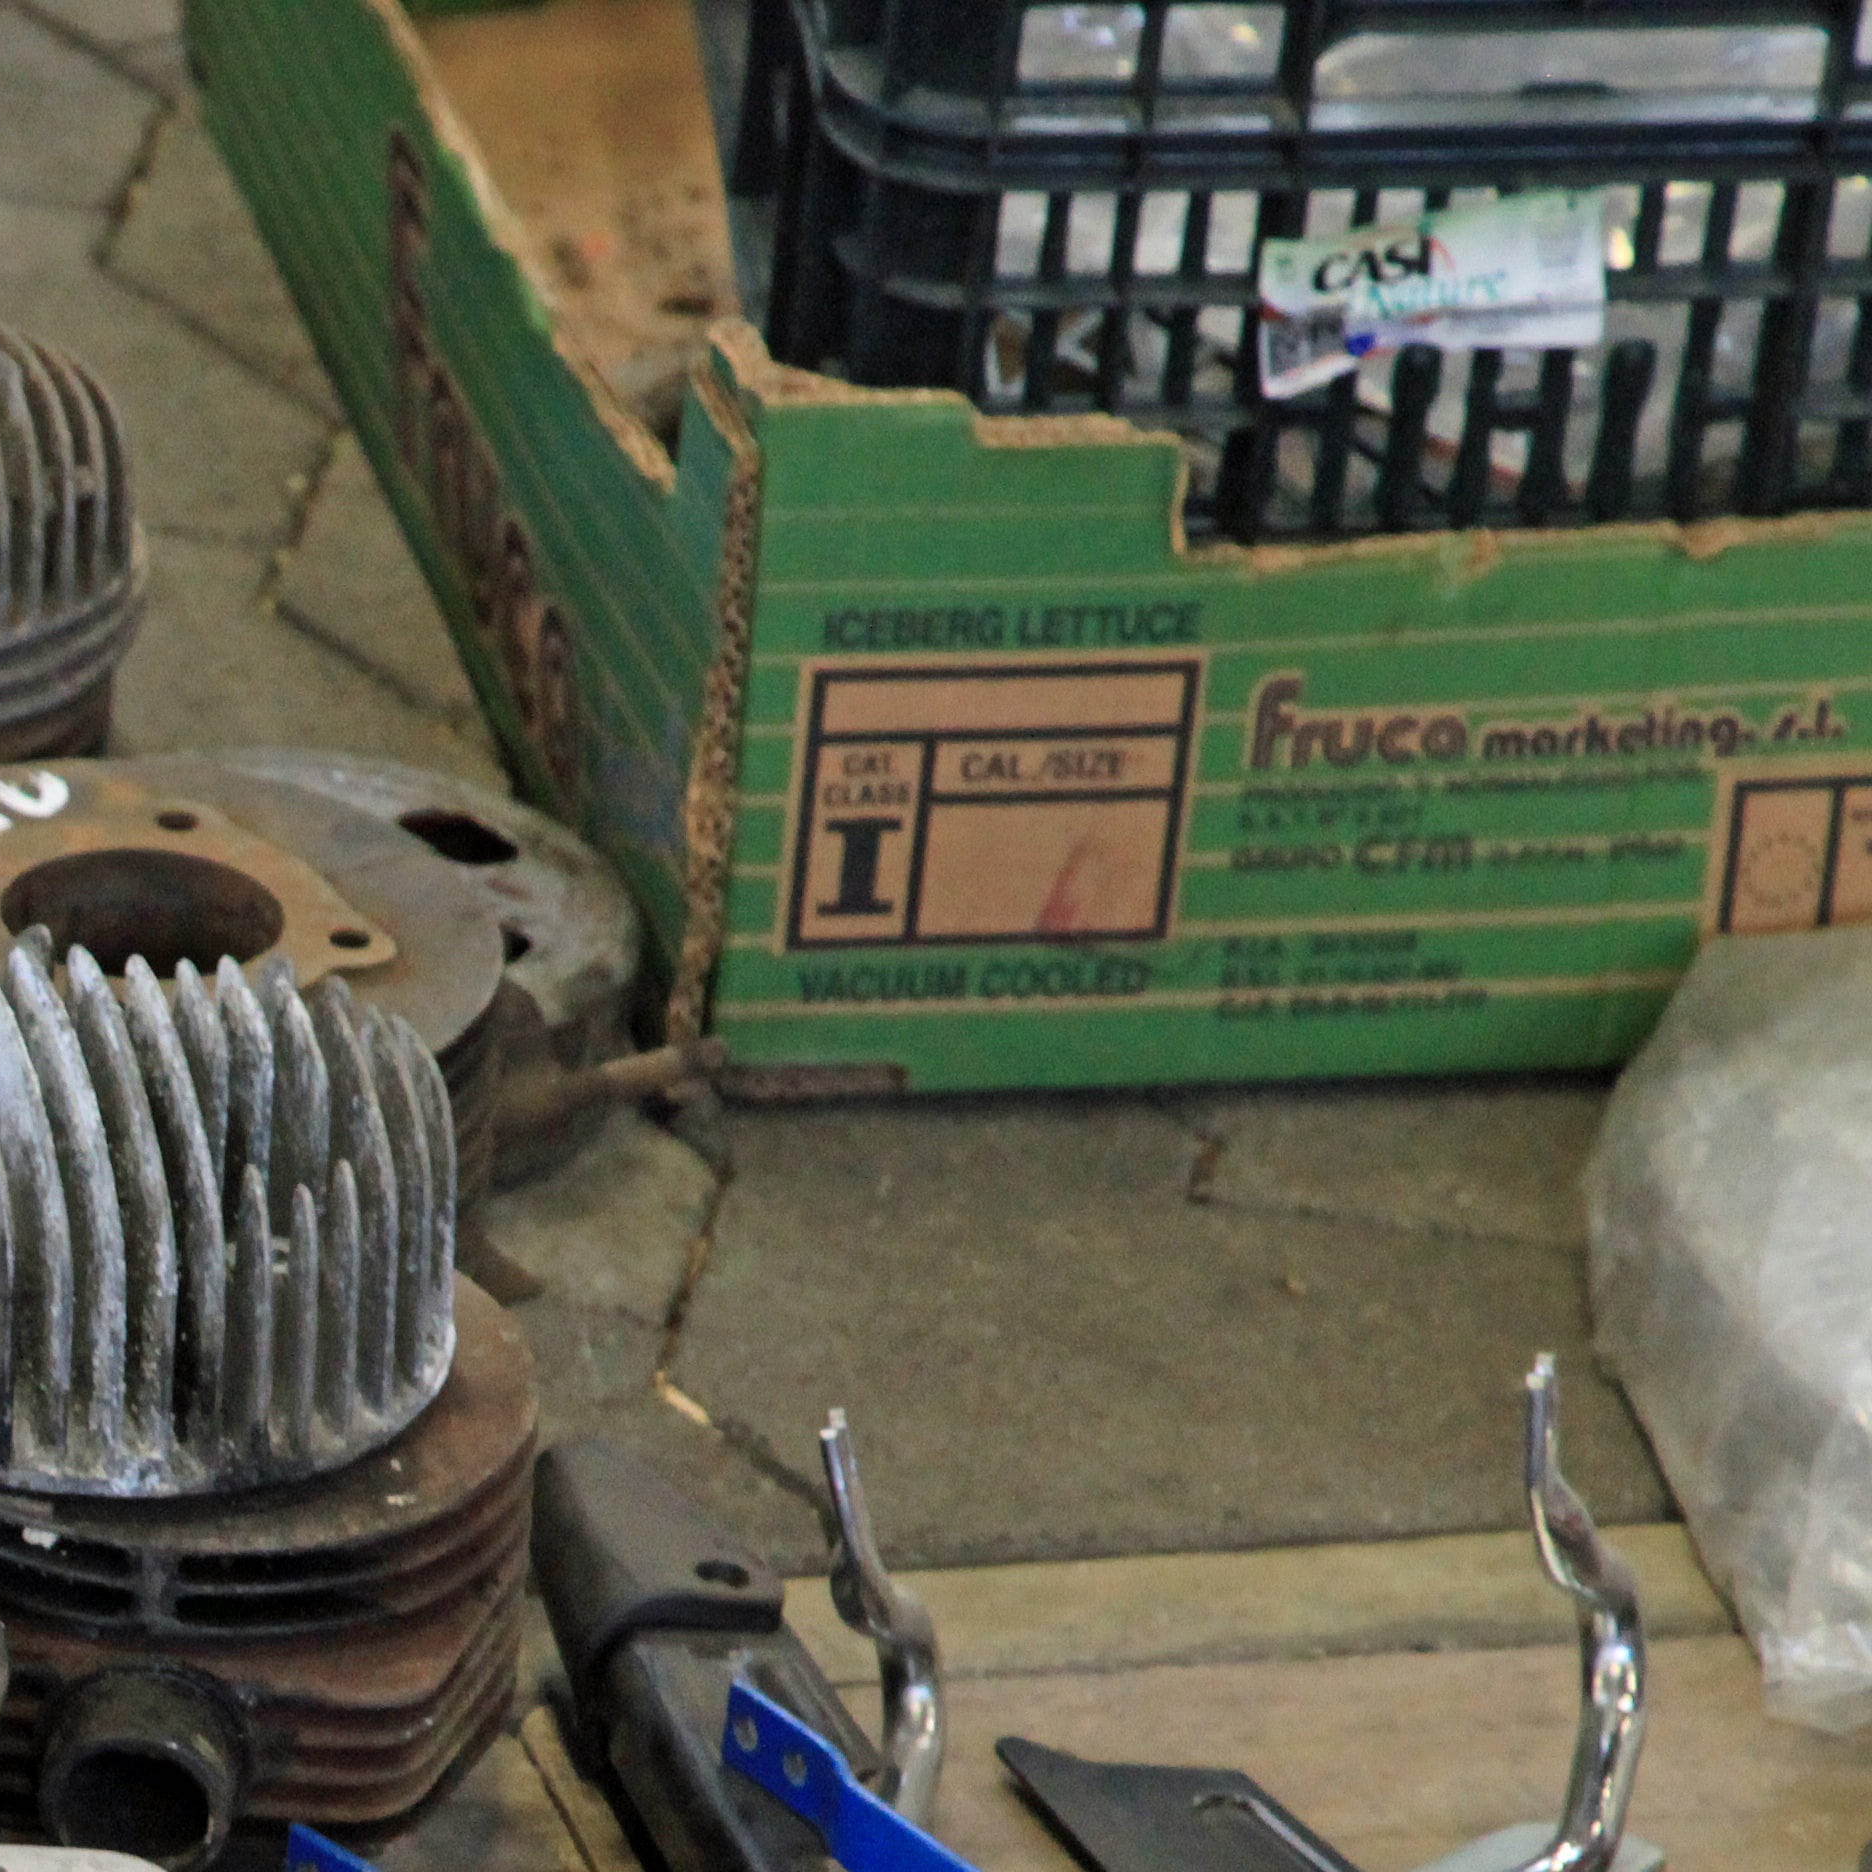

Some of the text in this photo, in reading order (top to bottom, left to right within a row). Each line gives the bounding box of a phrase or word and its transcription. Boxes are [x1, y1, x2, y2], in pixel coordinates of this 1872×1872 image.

[824, 601, 1203, 649] ICEBERG LETTUCE
[824, 781, 911, 809] CLASS
[798, 953, 1151, 1002] VACUUM COOLED
